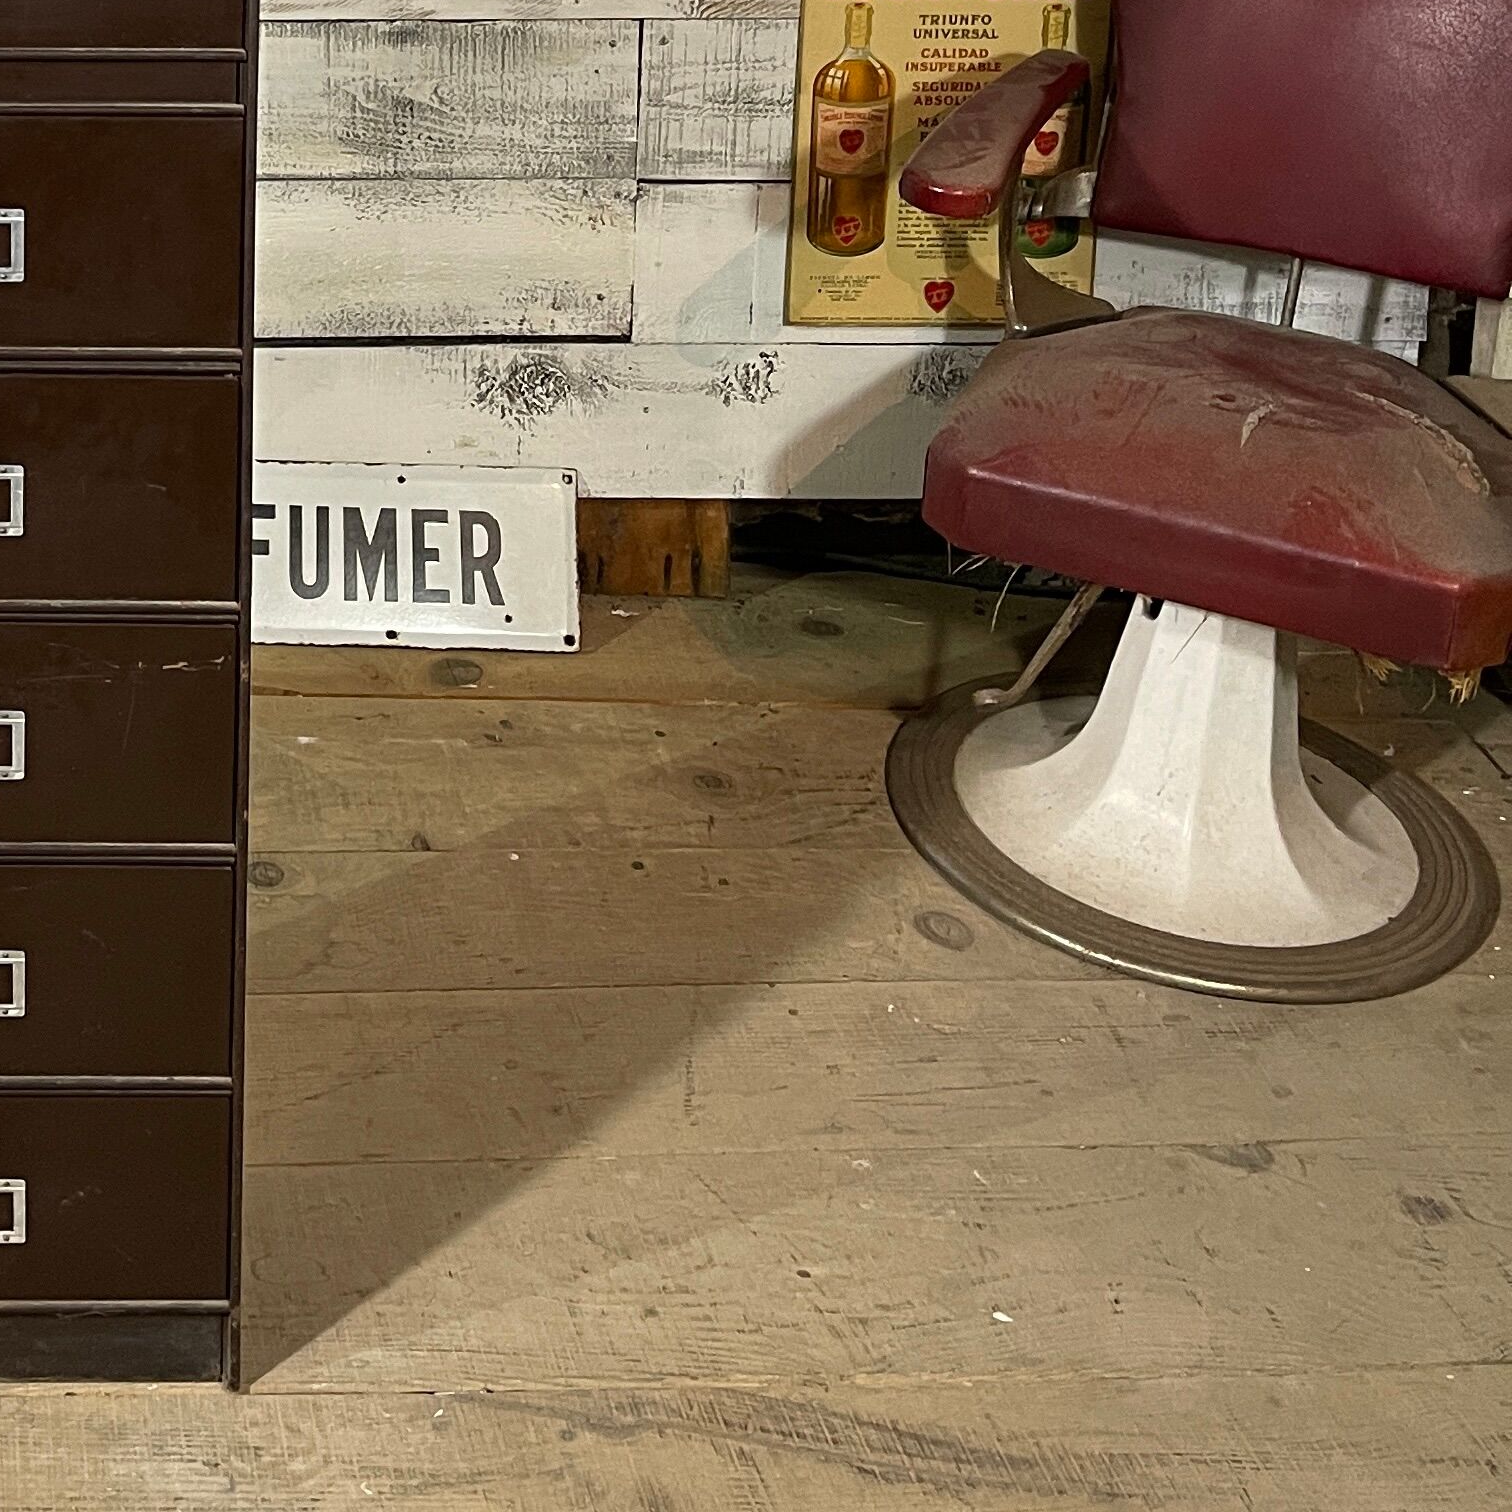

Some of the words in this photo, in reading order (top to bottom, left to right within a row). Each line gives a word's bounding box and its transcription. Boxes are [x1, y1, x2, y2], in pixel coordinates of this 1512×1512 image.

[918, 13, 992, 26] TRIUNFO
[912, 28, 1000, 40] UNIVERSAL
[920, 48, 989, 59] CALIDAD
[905, 61, 1003, 73] INSUPERABLE
[912, 81, 988, 93] SEGURIDA
